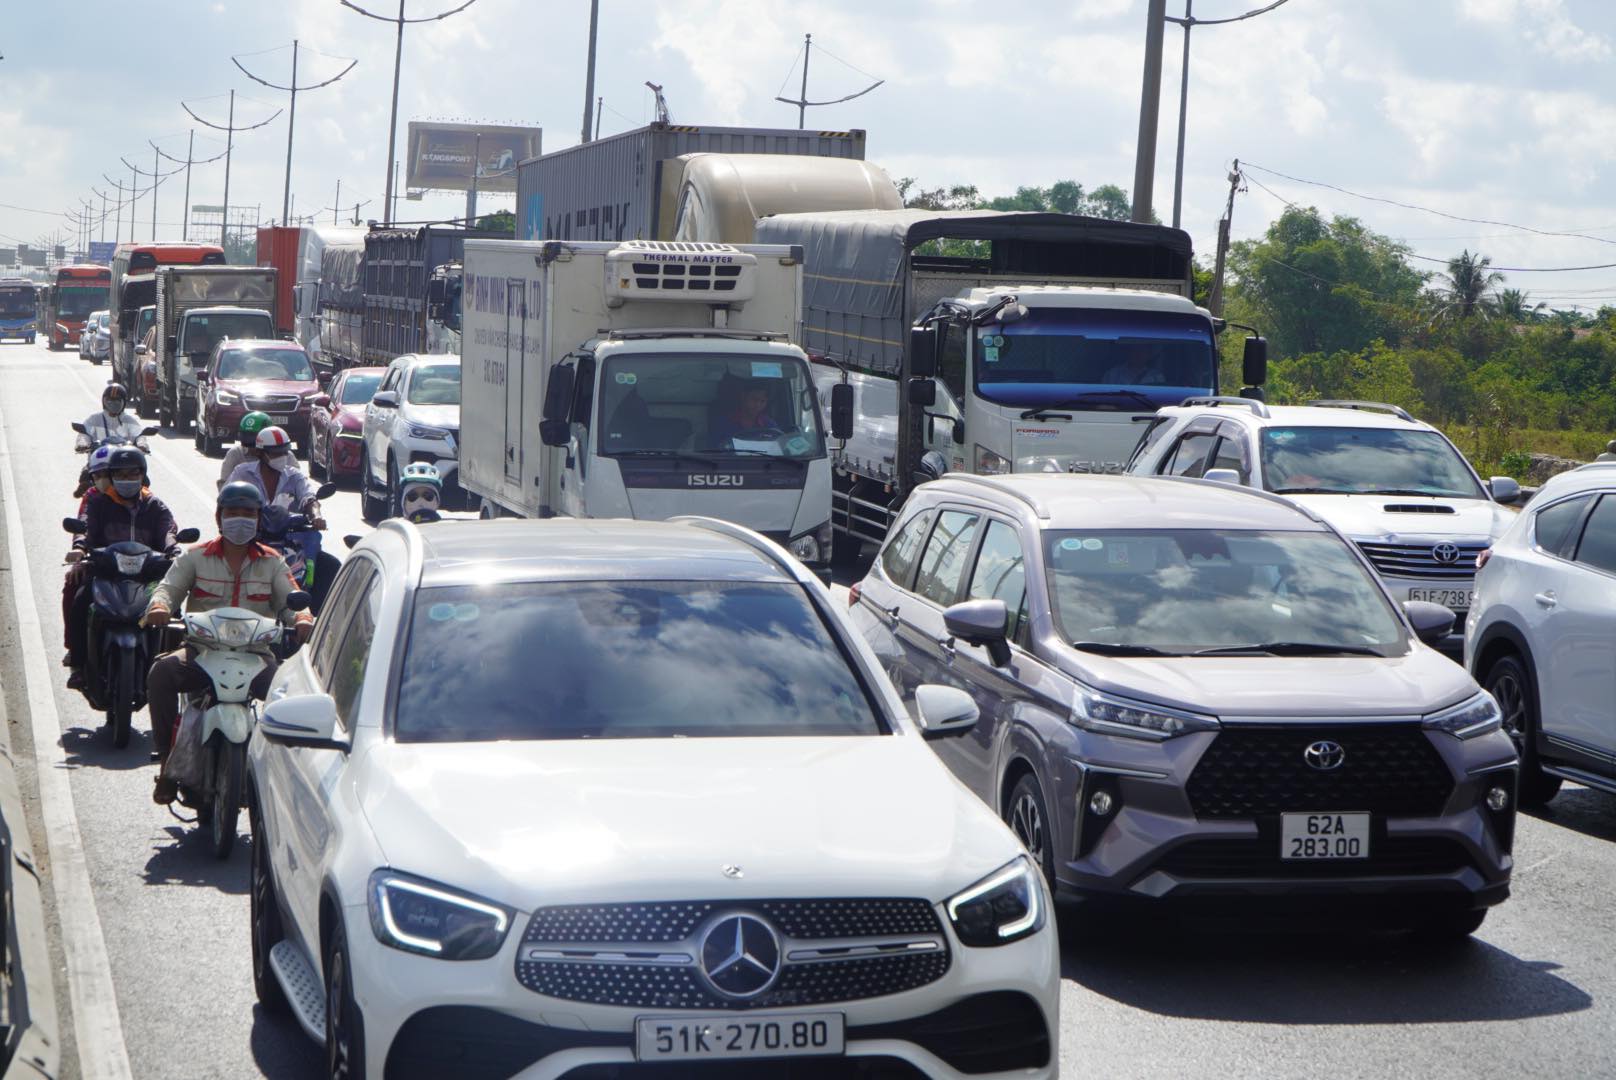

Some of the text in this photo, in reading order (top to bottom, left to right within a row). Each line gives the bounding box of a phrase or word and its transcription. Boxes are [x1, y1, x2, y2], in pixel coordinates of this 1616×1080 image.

[643, 253, 734, 264] THERMAL MASTER
[687, 474, 744, 486] ISUZU
[1307, 815, 1345, 835] 62A
[1290, 837, 1360, 858] 283.00
[656, 1020, 828, 1053] 51K-270.80
